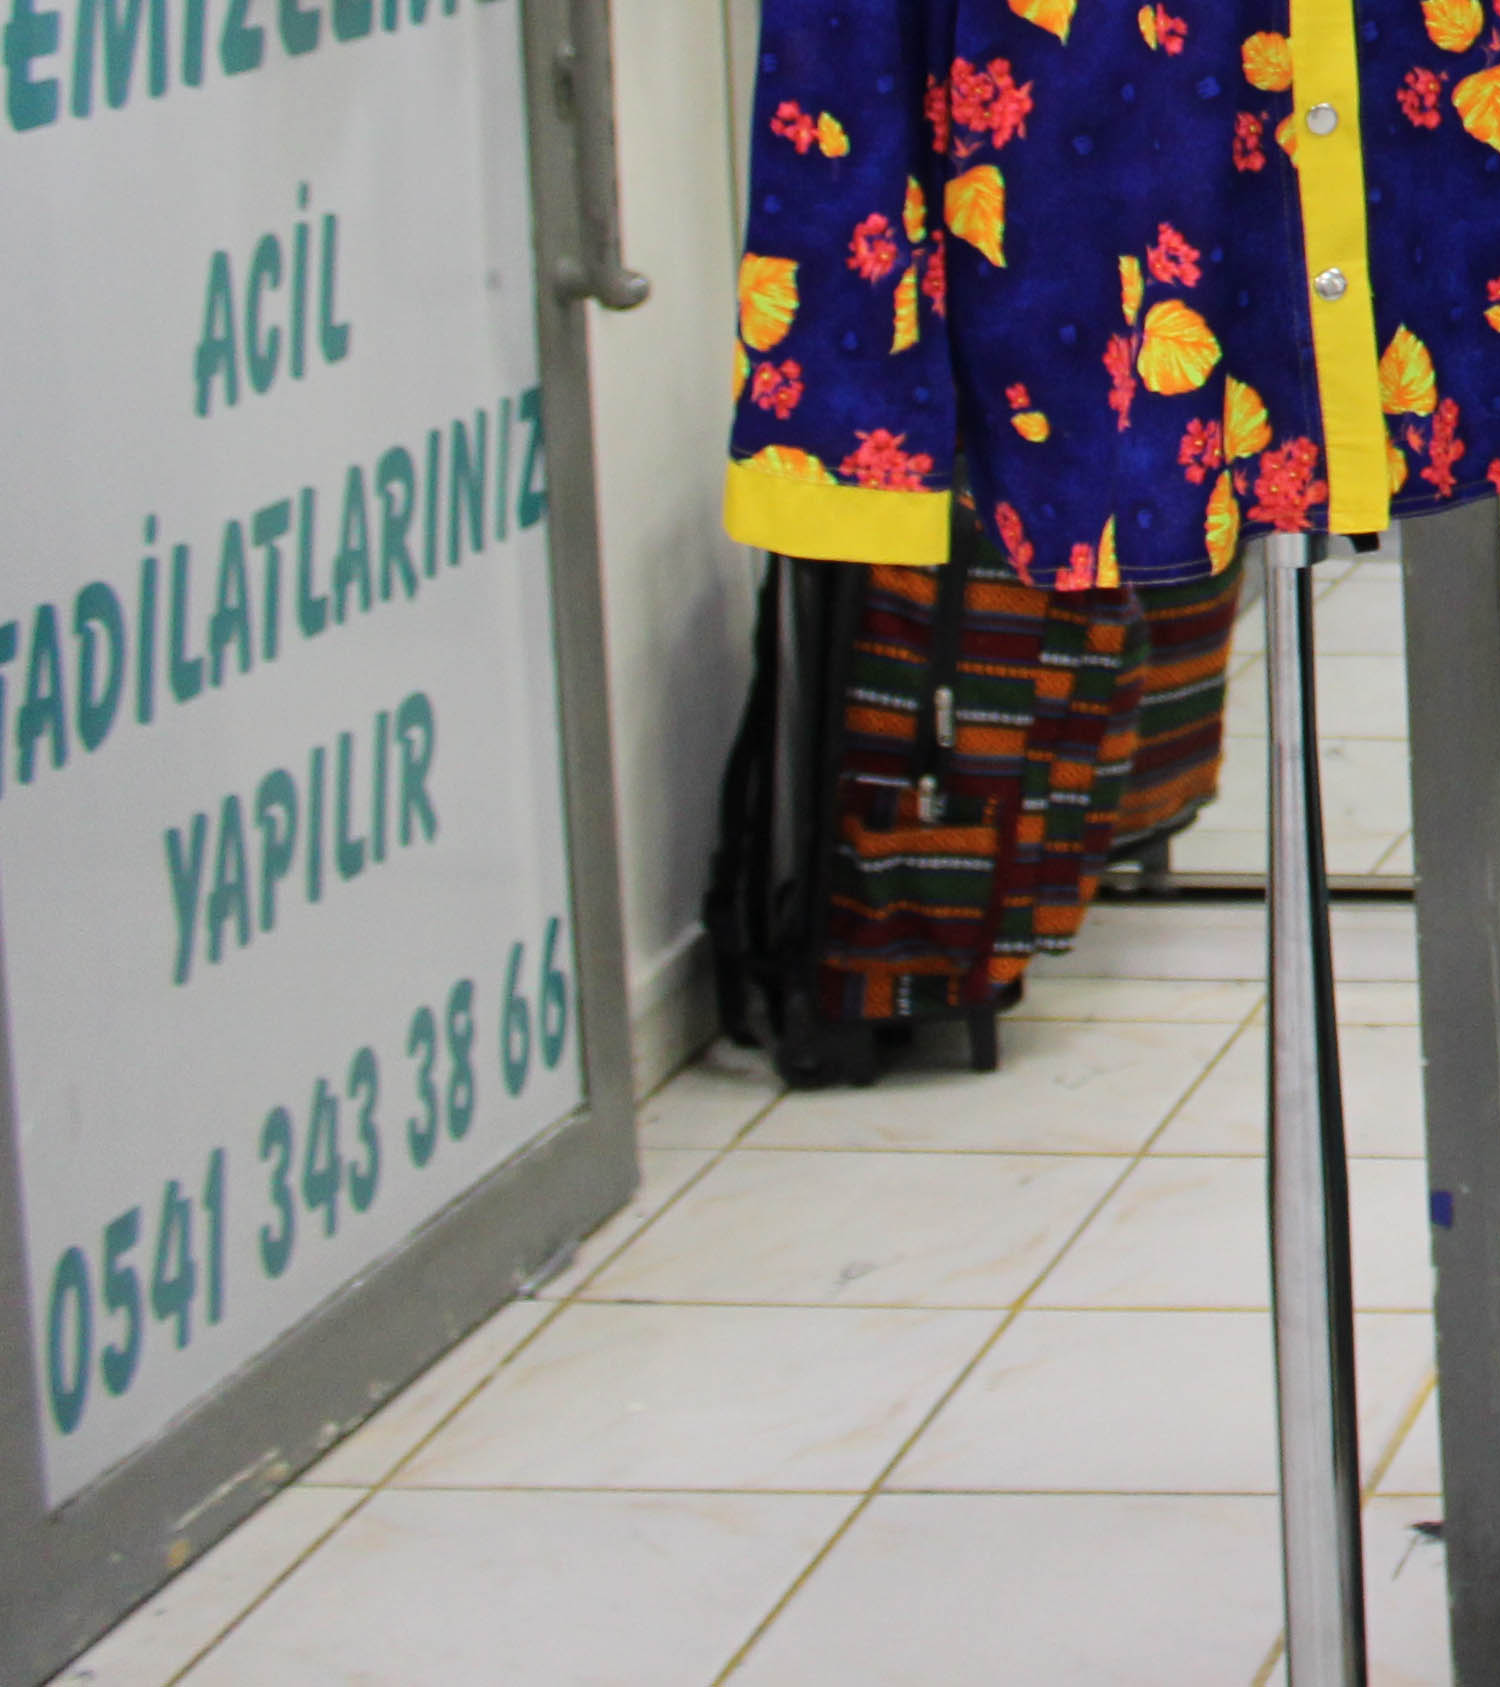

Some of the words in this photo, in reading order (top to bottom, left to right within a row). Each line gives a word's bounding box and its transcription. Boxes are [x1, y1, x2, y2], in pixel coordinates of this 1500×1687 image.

[193, 182, 350, 419] ACİL
[163, 691, 440, 987] YAPILIR
[46, 1148, 226, 1436] 0541
[259, 1047, 382, 1278] 343
[406, 979, 476, 1169] 38
[499, 916, 570, 1099] 66
